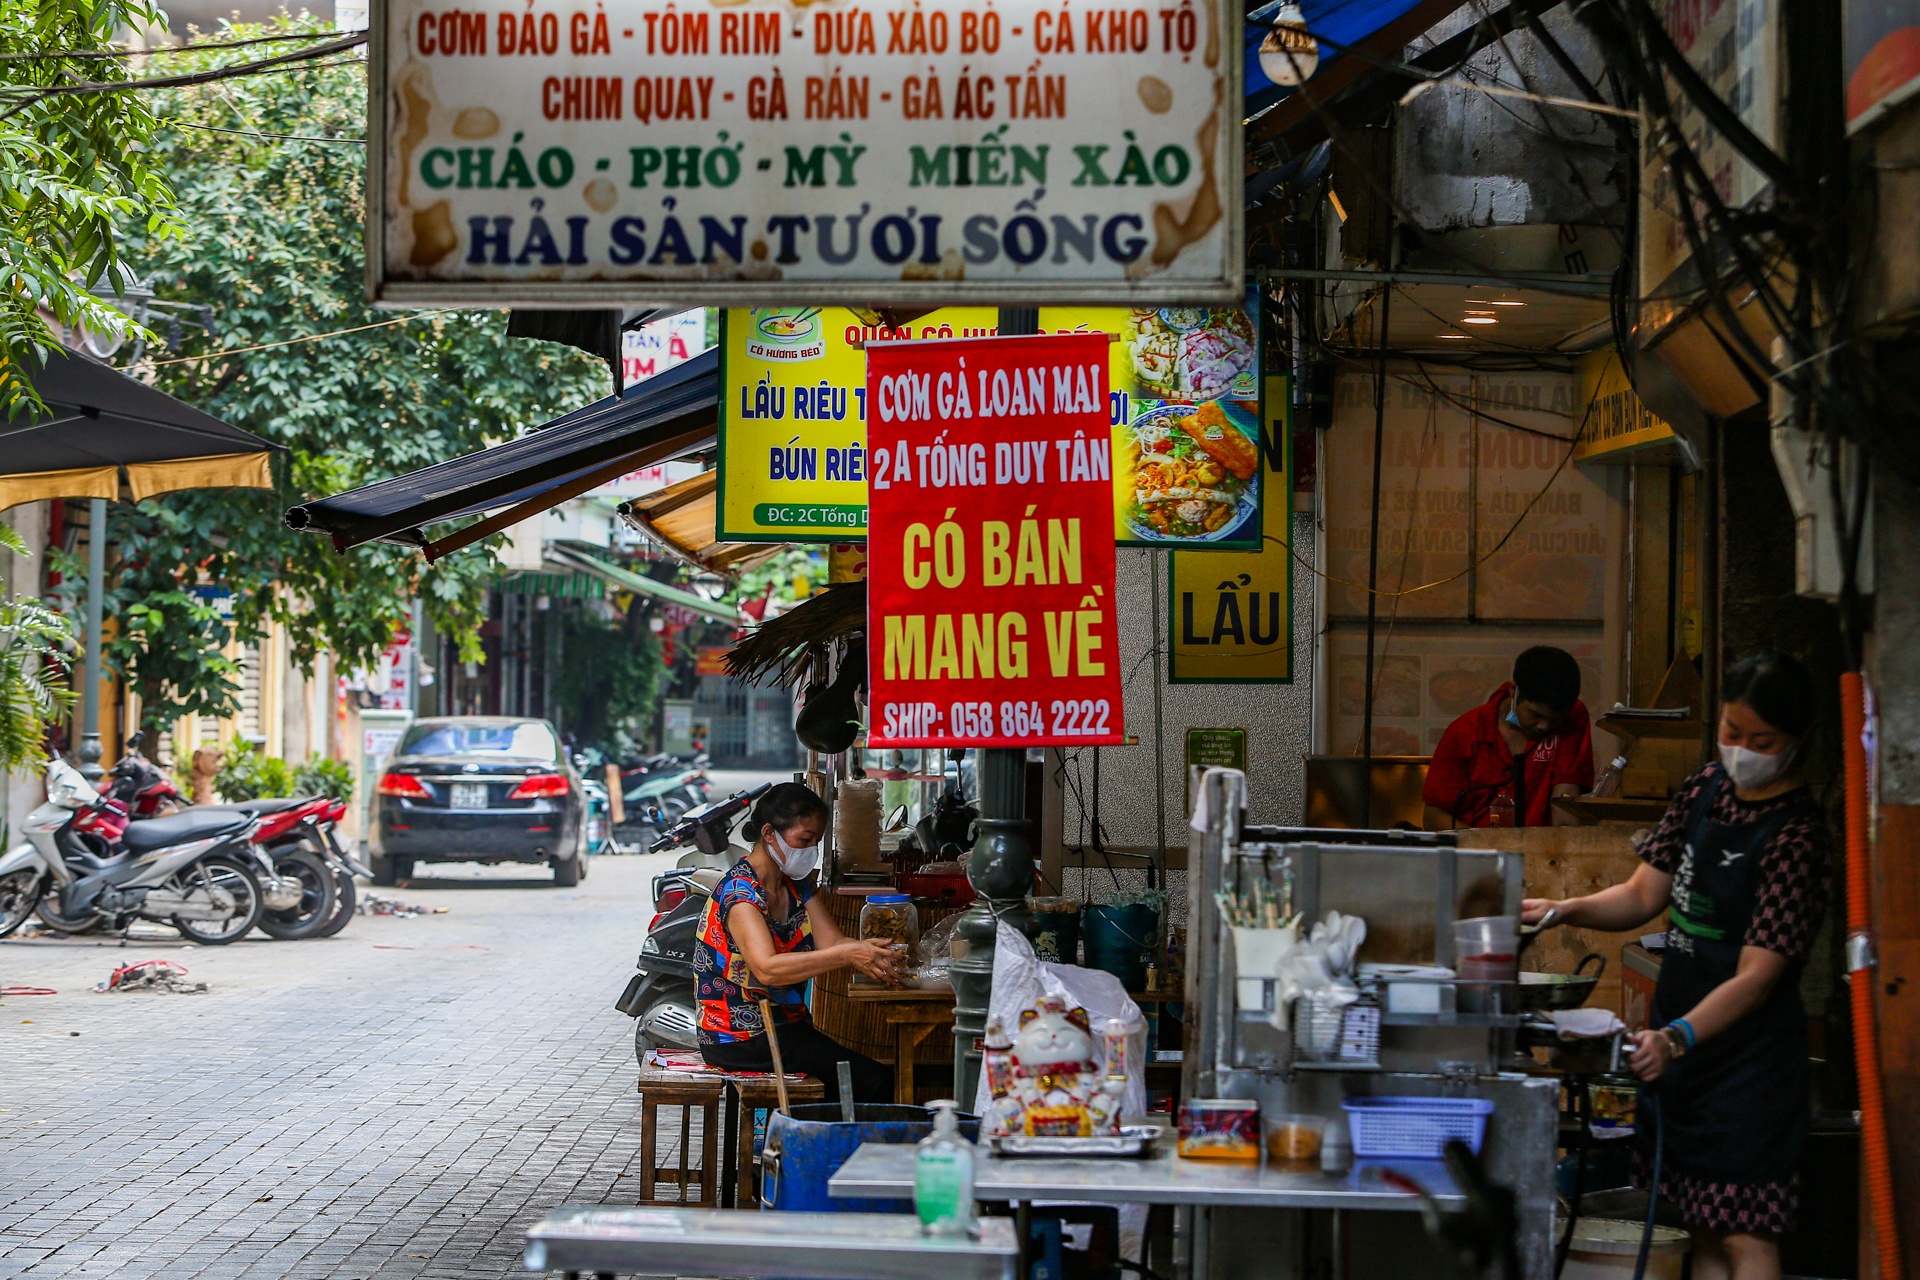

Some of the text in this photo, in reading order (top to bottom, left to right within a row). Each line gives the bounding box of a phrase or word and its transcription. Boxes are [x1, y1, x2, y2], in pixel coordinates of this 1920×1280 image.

[417, 9, 487, 56] CƠM
[497, 0, 558, 56] ĐẢO
[570, 2, 611, 56] GÀ
[643, 3, 709, 55] TÔM
[720, 12, 780, 55] RIM
[887, 1, 948, 55] XÀO
[960, 1, 1000, 55] BÒ
[1034, 1, 1075, 54] CÁ
[1086, 9, 1149, 54] KHO
[1159, 0, 1197, 63] TỘ
[542, 76, 622, 120] CHIM
[633, 76, 714, 124] QUAY
[747, 67, 788, 120] GÀ
[804, 66, 869, 120] RÁN
[902, 66, 943, 120] GÀ
[954, 65, 995, 120] ÁC
[420, 124, 1191, 188] CHÁO PHỞ MỲ MIẾN XÀO
[466, 187, 1149, 265] HẢI SẢN TƯƠI SỐNG
[766, 348, 798, 359] HƯƠNG
[741, 370, 785, 420] LẨU
[794, 380, 846, 421] RIÊU
[878, 356, 1101, 423] CƠM GÀ LOAN MAI
[770, 436, 868, 482] BÚN RIÊ
[915, 430, 987, 488] TỐNG
[995, 441, 1048, 486] DUY
[1056, 430, 1110, 482] TÂN
[768, 508, 794, 522] ĐC:
[798, 508, 817, 522] 2C
[820, 507, 857, 527] Tống
[903, 504, 1083, 590] CÓ BÁN
[883, 585, 1106, 681] MANG VỀ
[1182, 574, 1281, 647] LẨU
[883, 699, 1111, 738] SHIP: 058 864 2222
